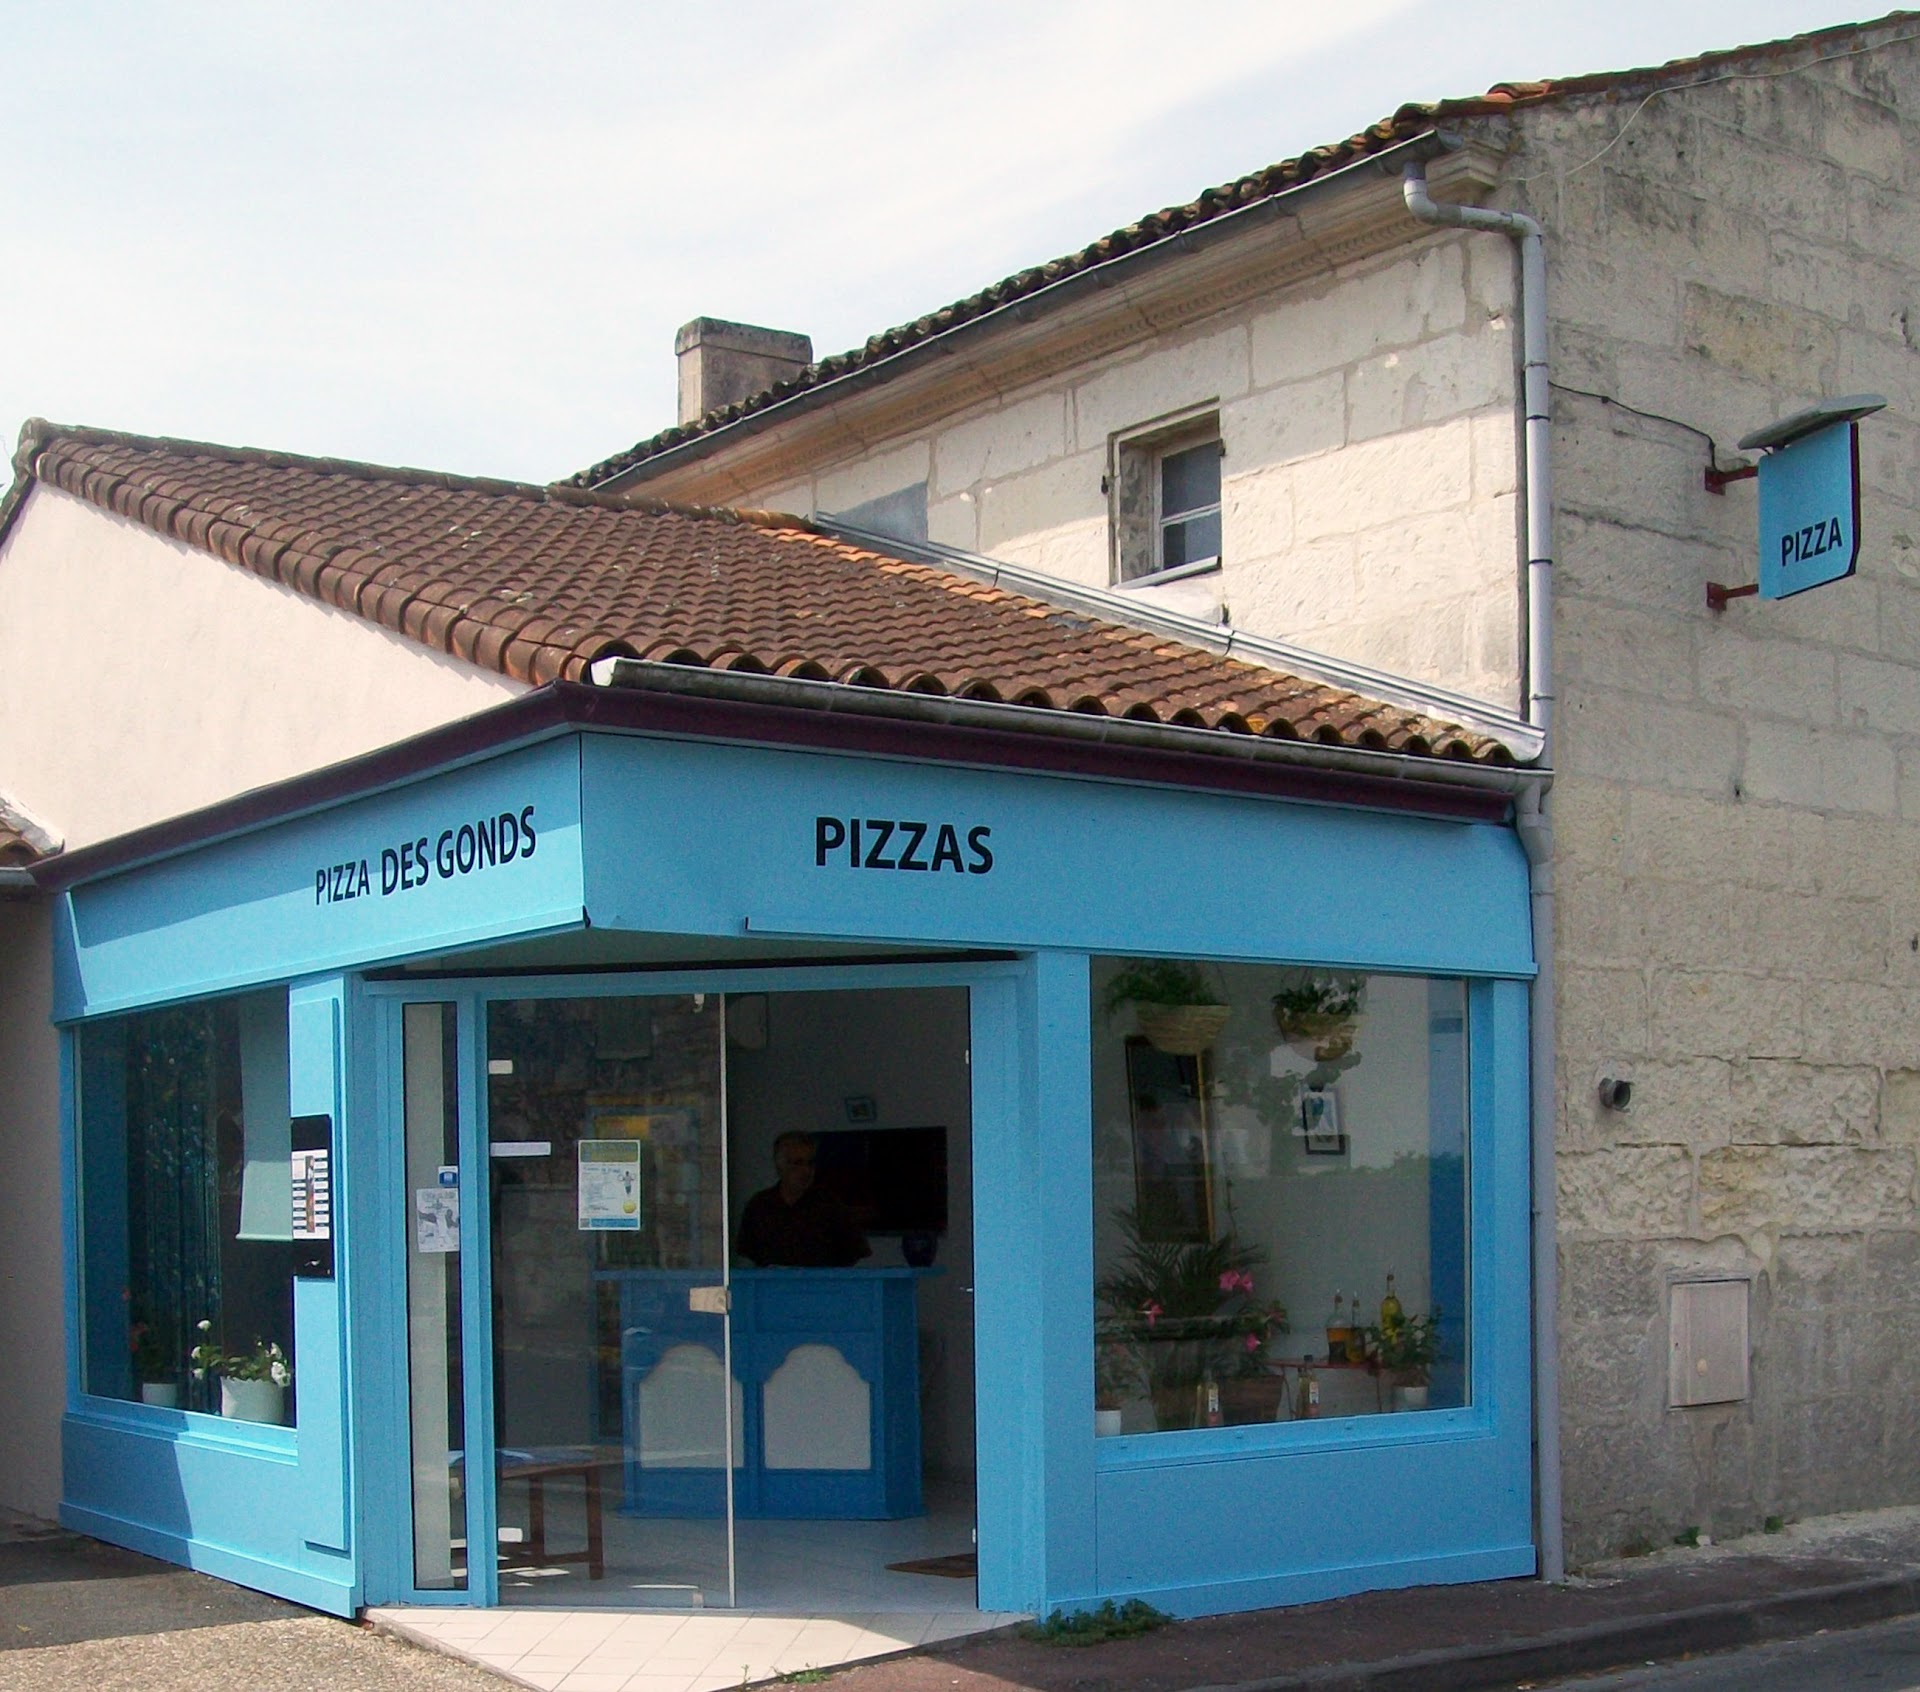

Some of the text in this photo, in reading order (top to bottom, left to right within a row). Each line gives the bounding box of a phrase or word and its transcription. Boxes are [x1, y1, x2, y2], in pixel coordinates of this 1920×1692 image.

[1782, 517, 1842, 567] PIZZA
[316, 806, 536, 905] PIZZA DES GONDS
[816, 817, 993, 874] PIZZAS
